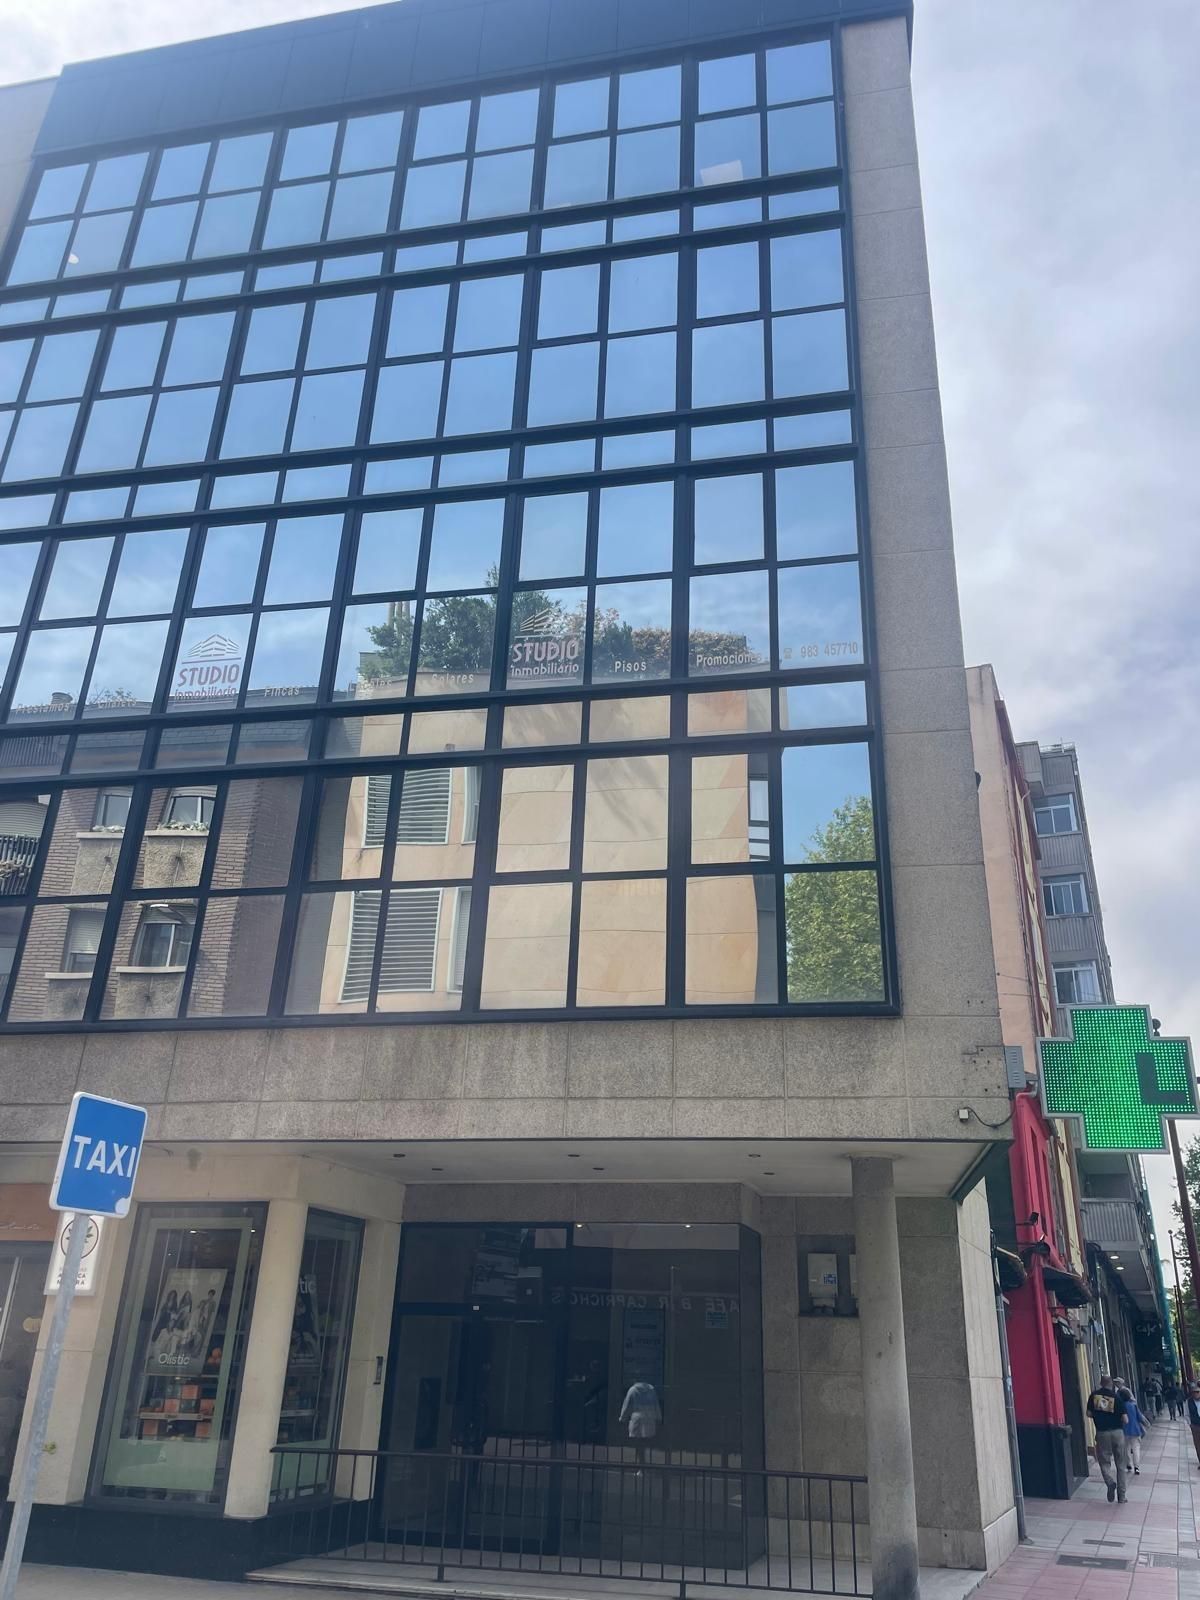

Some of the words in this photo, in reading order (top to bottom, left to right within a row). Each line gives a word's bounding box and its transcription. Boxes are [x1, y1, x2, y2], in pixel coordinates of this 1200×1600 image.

[512, 640, 579, 663] STUDIO
[800, 645, 819, 658] 983
[823, 641, 858, 656] 457710
[614, 660, 647, 673] Pisos
[696, 652, 762, 667] Promociones
[177, 664, 240, 687] STUDIO
[432, 672, 475, 688] Solares
[264, 686, 300, 697] Fincas
[73, 1135, 137, 1178] TAXI
